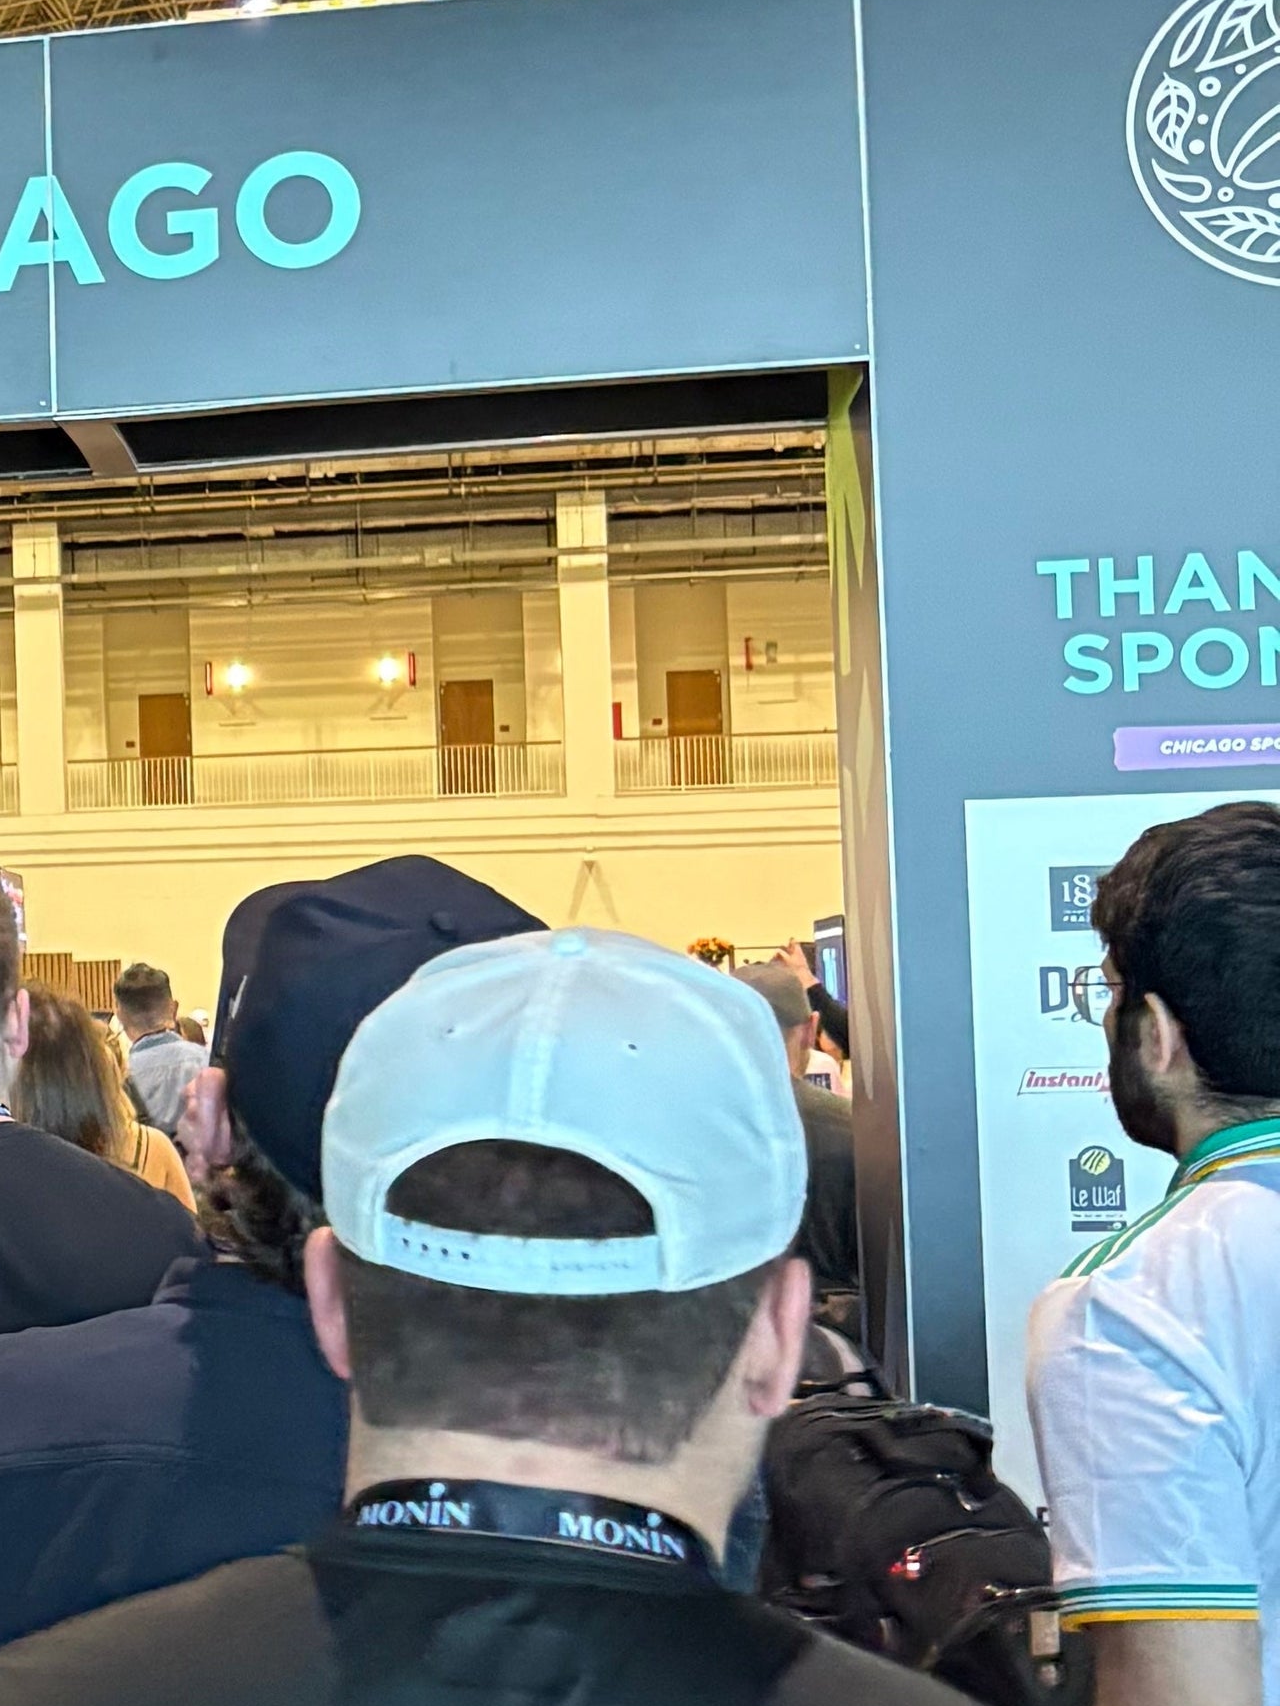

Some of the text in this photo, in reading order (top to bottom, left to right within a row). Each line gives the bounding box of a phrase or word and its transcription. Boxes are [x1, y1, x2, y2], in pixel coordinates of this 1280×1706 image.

[1160, 738, 1246, 755] CHICAGO
[1062, 874, 1097, 908] 188
[356, 1481, 471, 1528] MONIN
[558, 1511, 686, 1560] MONIN
